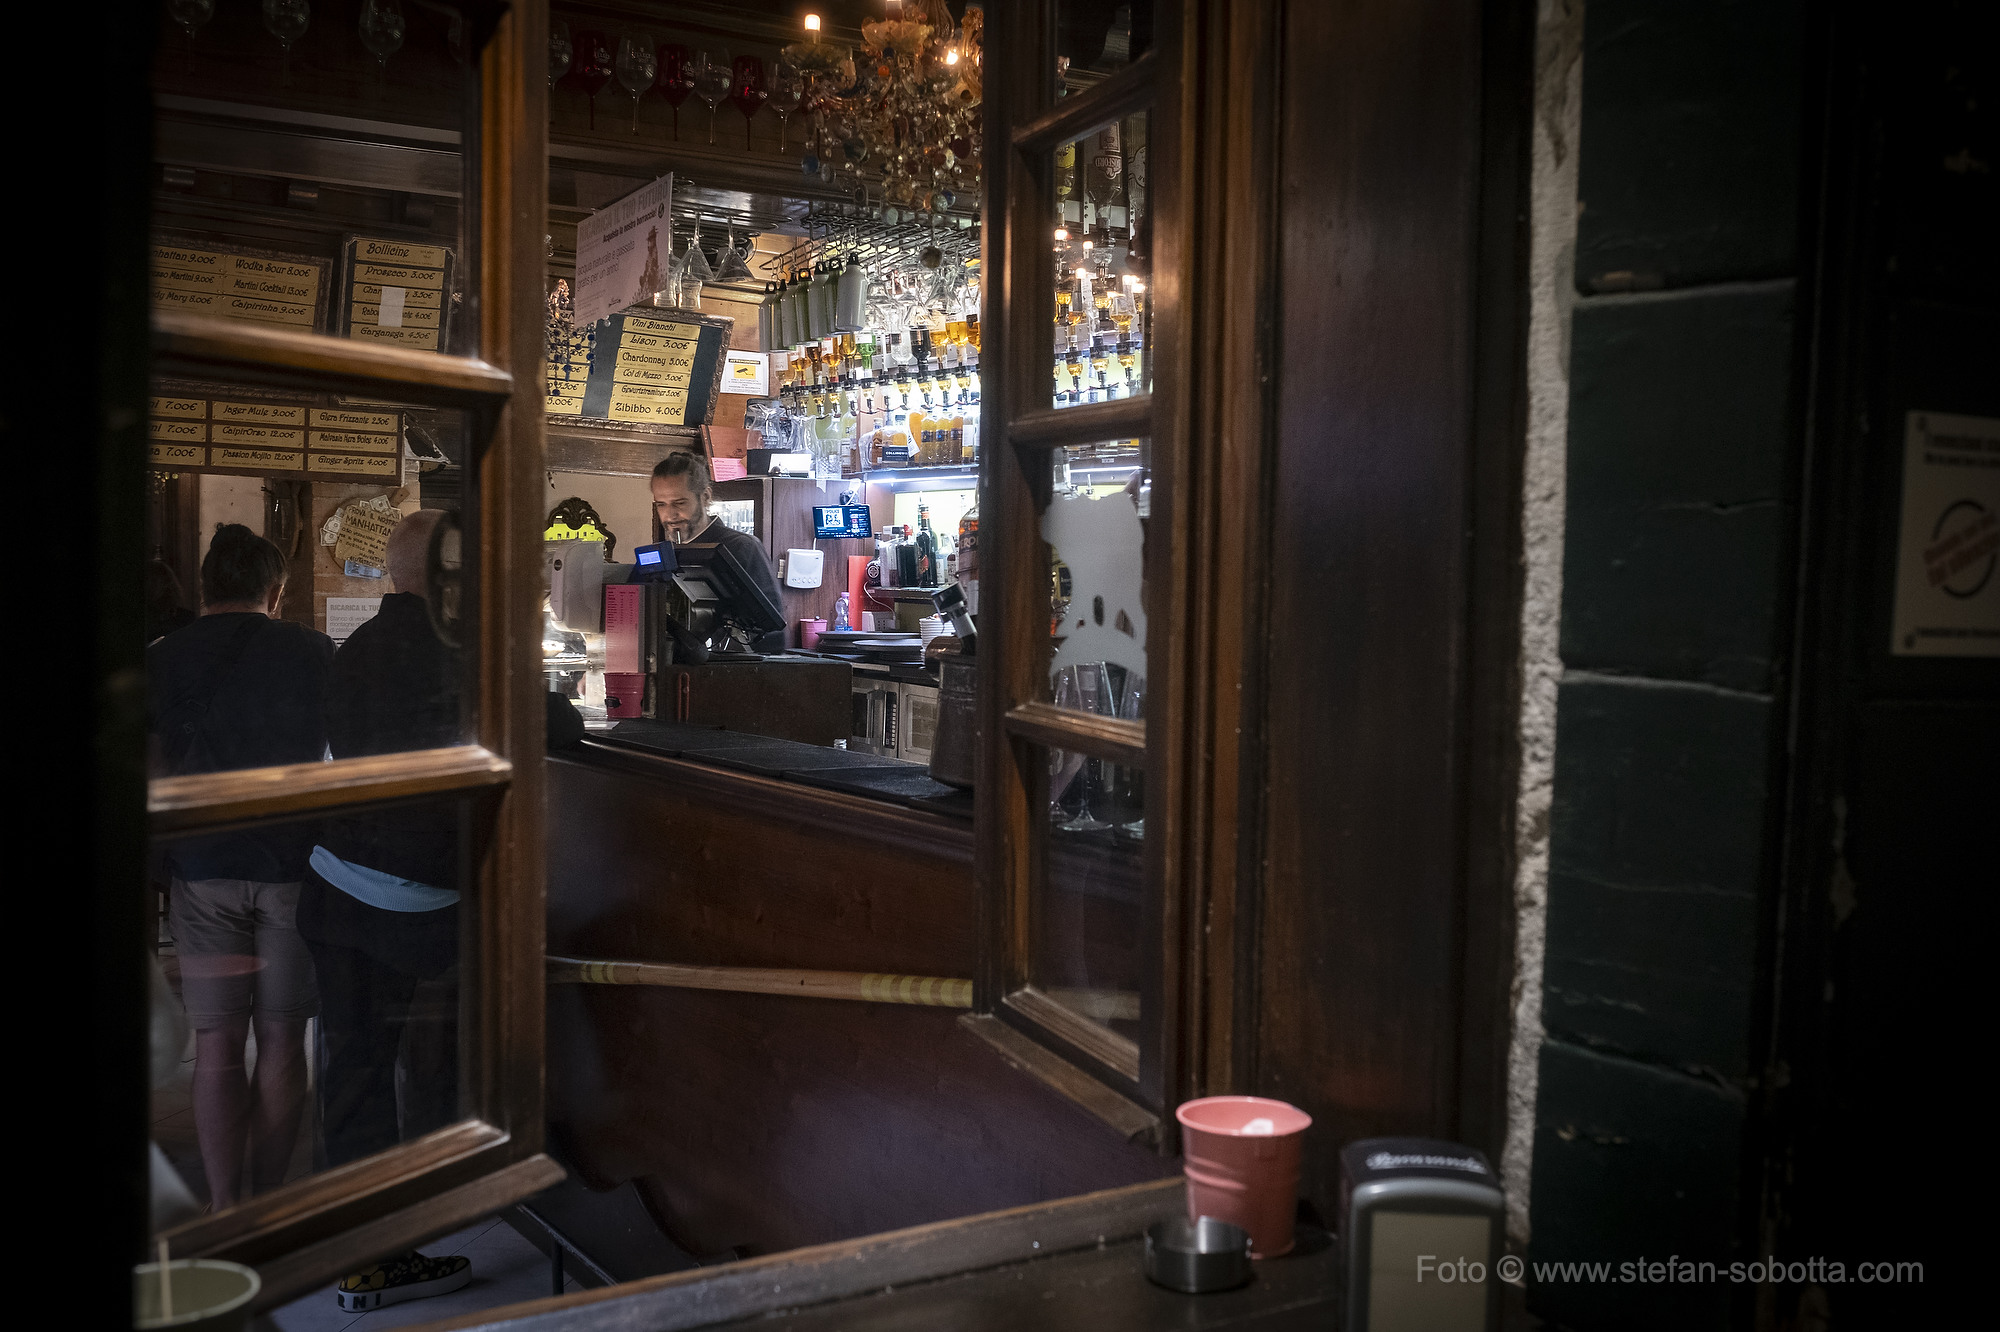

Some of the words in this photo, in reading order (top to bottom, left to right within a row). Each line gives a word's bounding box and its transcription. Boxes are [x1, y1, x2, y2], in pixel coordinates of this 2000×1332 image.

[638, 181, 668, 210] FUTURO
[367, 243, 409, 257] Bollicine
[188, 254, 216, 265] 9.00€
[235, 259, 263, 271] Wodka
[265, 263, 286, 274] Sour
[287, 267, 311, 277] 8.00€
[364, 266, 407, 277] Prosecco
[410, 271, 435, 279] 3.00€
[170, 271, 194, 282] Martini
[194, 275, 215, 284] 9.00€
[234, 279, 258, 291] Martini
[260, 281, 286, 294] Cocktail
[166, 292, 187, 303] Mary
[413, 291, 434, 299] 3.50€
[231, 299, 278, 312] Caipirinha
[279, 304, 306, 315] 9.00€
[631, 319, 646, 328] Vini
[647, 321, 676, 331] Bianchi
[630, 335, 656, 346] Lison
[663, 340, 689, 350] 3.00€
[622, 352, 666, 366] Chardonnay
[669, 357, 689, 366] 5.00€
[623, 369, 633, 377] Col
[634, 370, 641, 378] di
[165, 401, 197, 410] 7.00€
[547, 397, 573, 406] 5.00€
[248, 407, 268, 416] Mule
[271, 409, 296, 417] 9.00€
[615, 402, 651, 413] Zibibbo
[656, 406, 681, 416] 4.00€
[339, 413, 369, 424] Frizzante
[167, 424, 197, 434] 7.00€
[270, 430, 296, 439] 12.00€
[166, 447, 196, 457] 7.00€
[222, 449, 249, 459] Passion
[250, 451, 271, 461] Mojito
[318, 456, 342, 465] Ginger
[343, 457, 364, 466] Spritz
[367, 459, 388, 467] 4.00€
[346, 515, 391, 536] MANHATTAN
